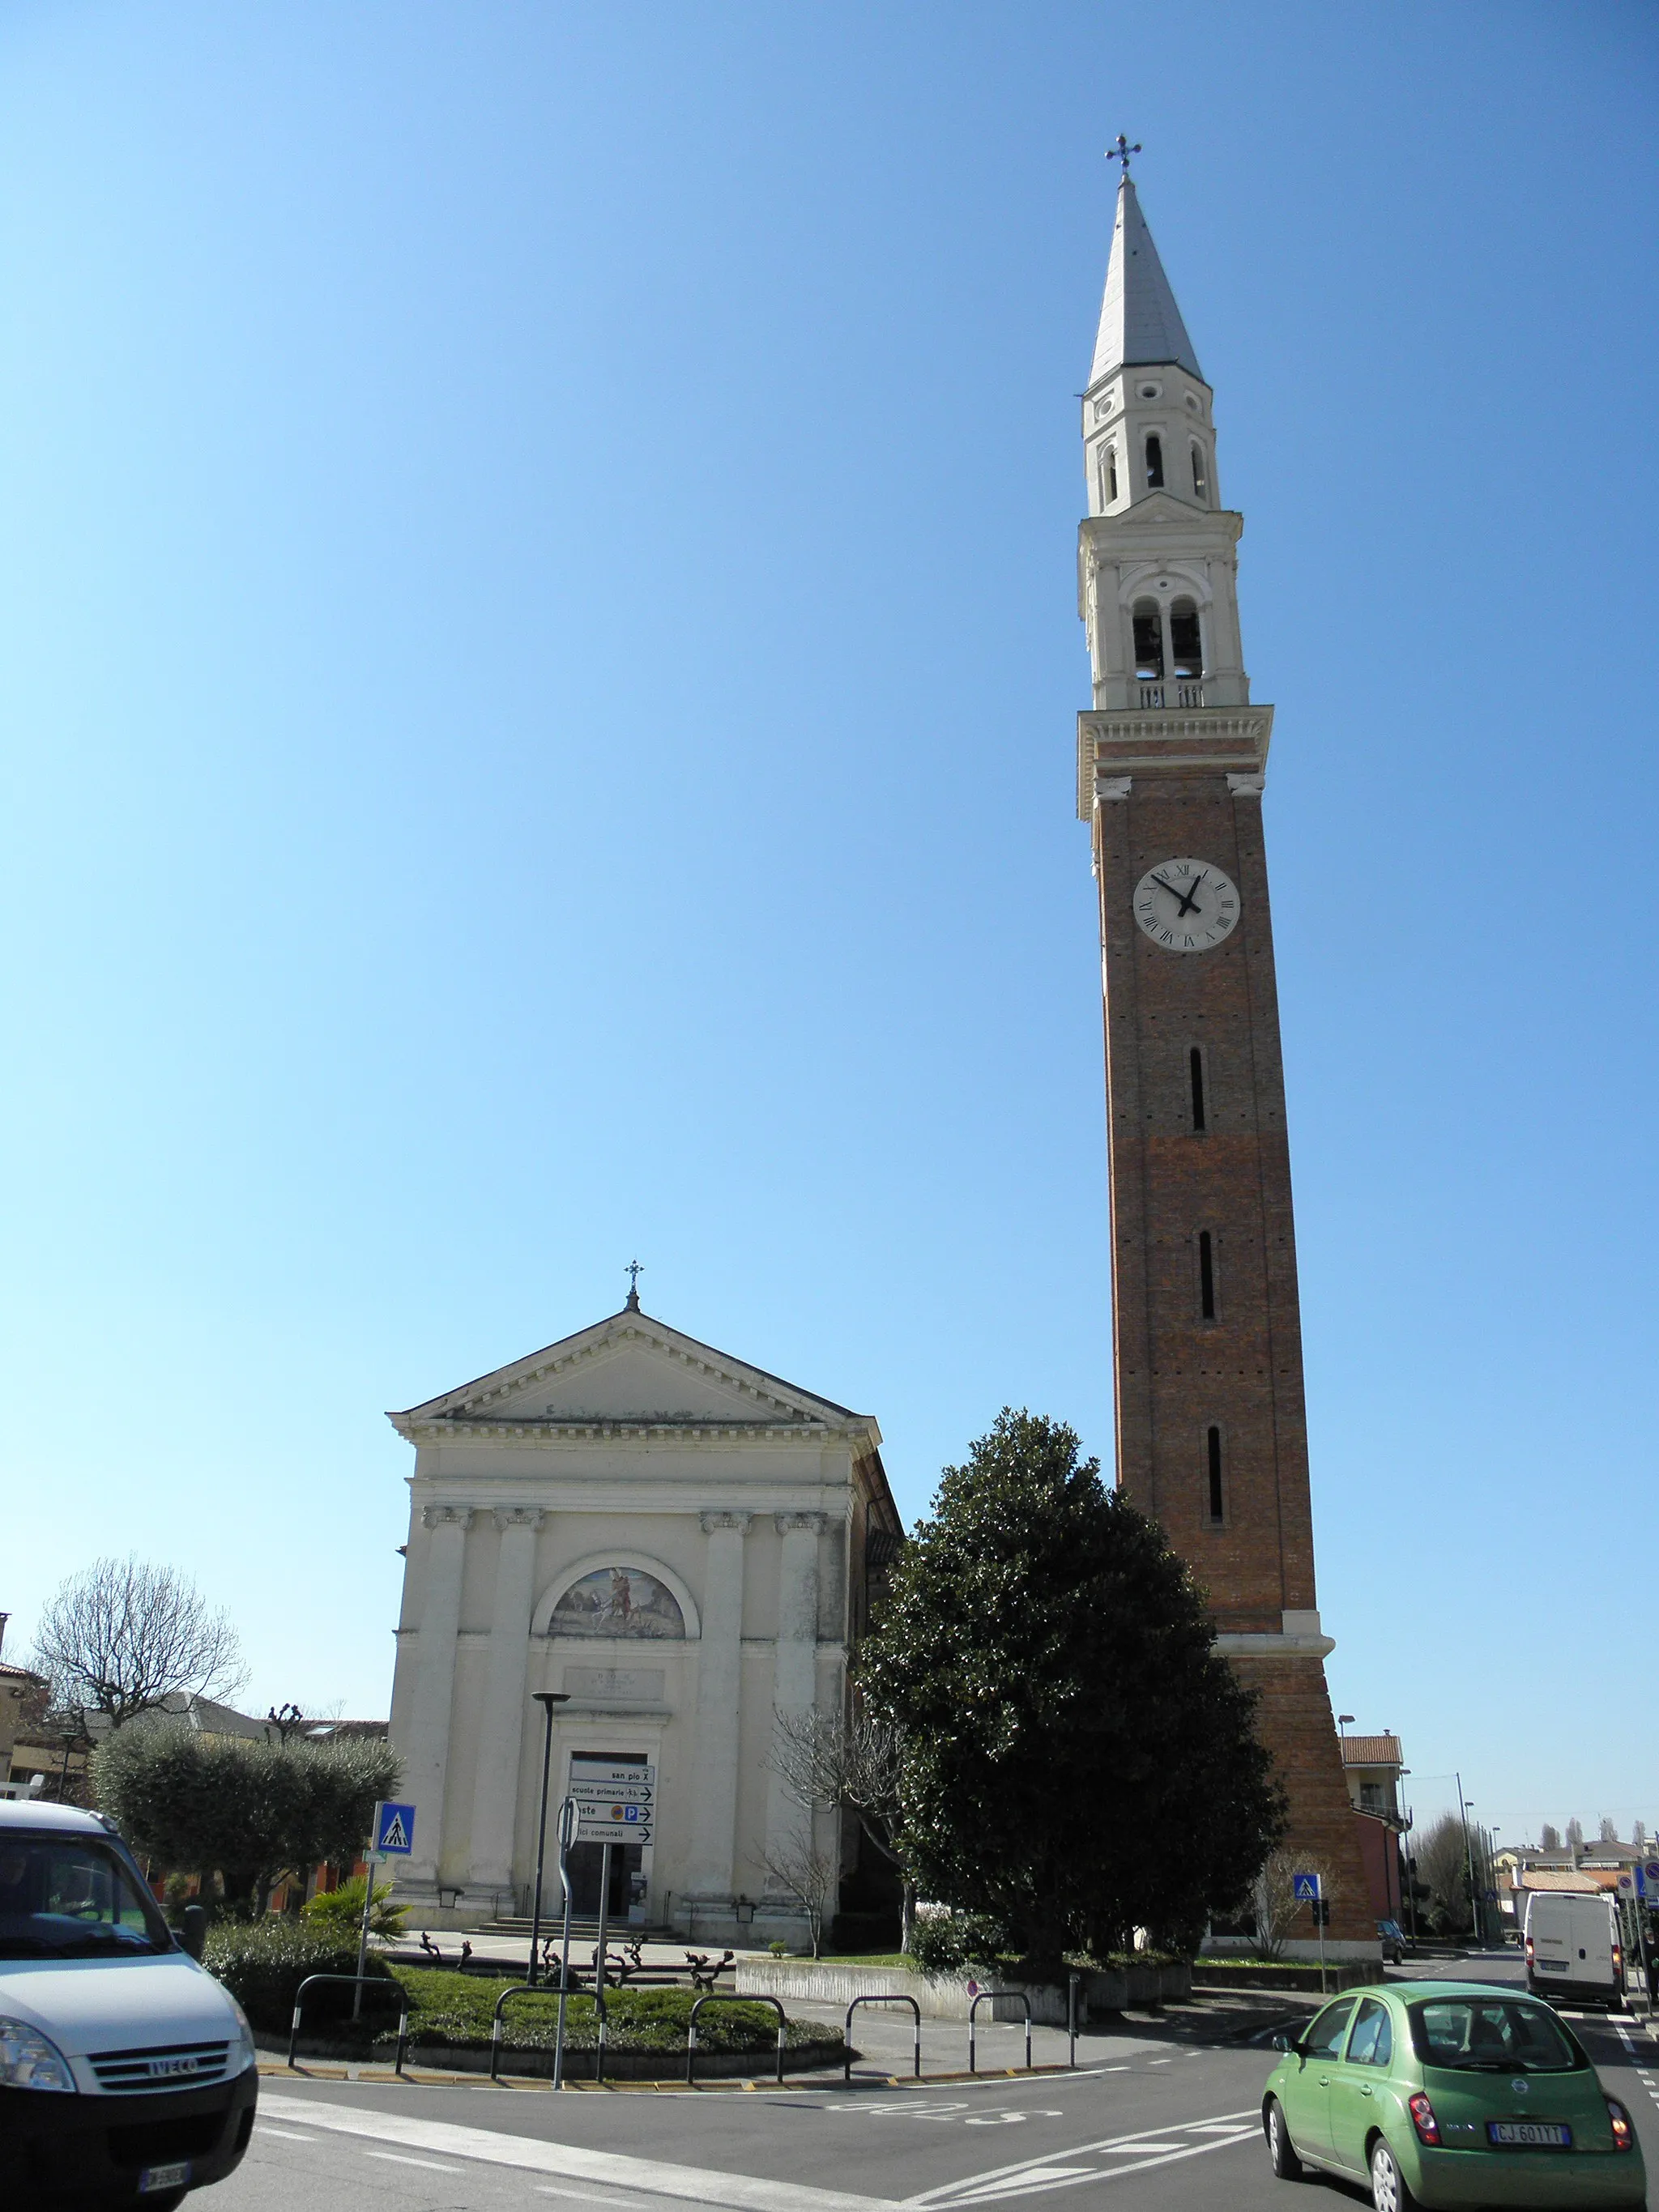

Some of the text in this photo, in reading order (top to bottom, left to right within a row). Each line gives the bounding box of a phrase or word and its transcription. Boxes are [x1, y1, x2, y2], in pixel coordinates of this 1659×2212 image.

[1176, 865, 1189, 876] XII
[1215, 882, 1227, 891] II
[1222, 900, 1234, 908] III
[1143, 916, 1158, 931] VIII
[1160, 931, 1173, 944] VII
[1184, 936, 1195, 947] VI
[581, 1806, 595, 1814] ste
[591, 1829, 623, 1837] comunali
[149, 2058, 198, 2076] IVECO
[825, 2101, 1063, 2125] STOP
[1499, 2125, 1559, 2142] CJ 601YT
